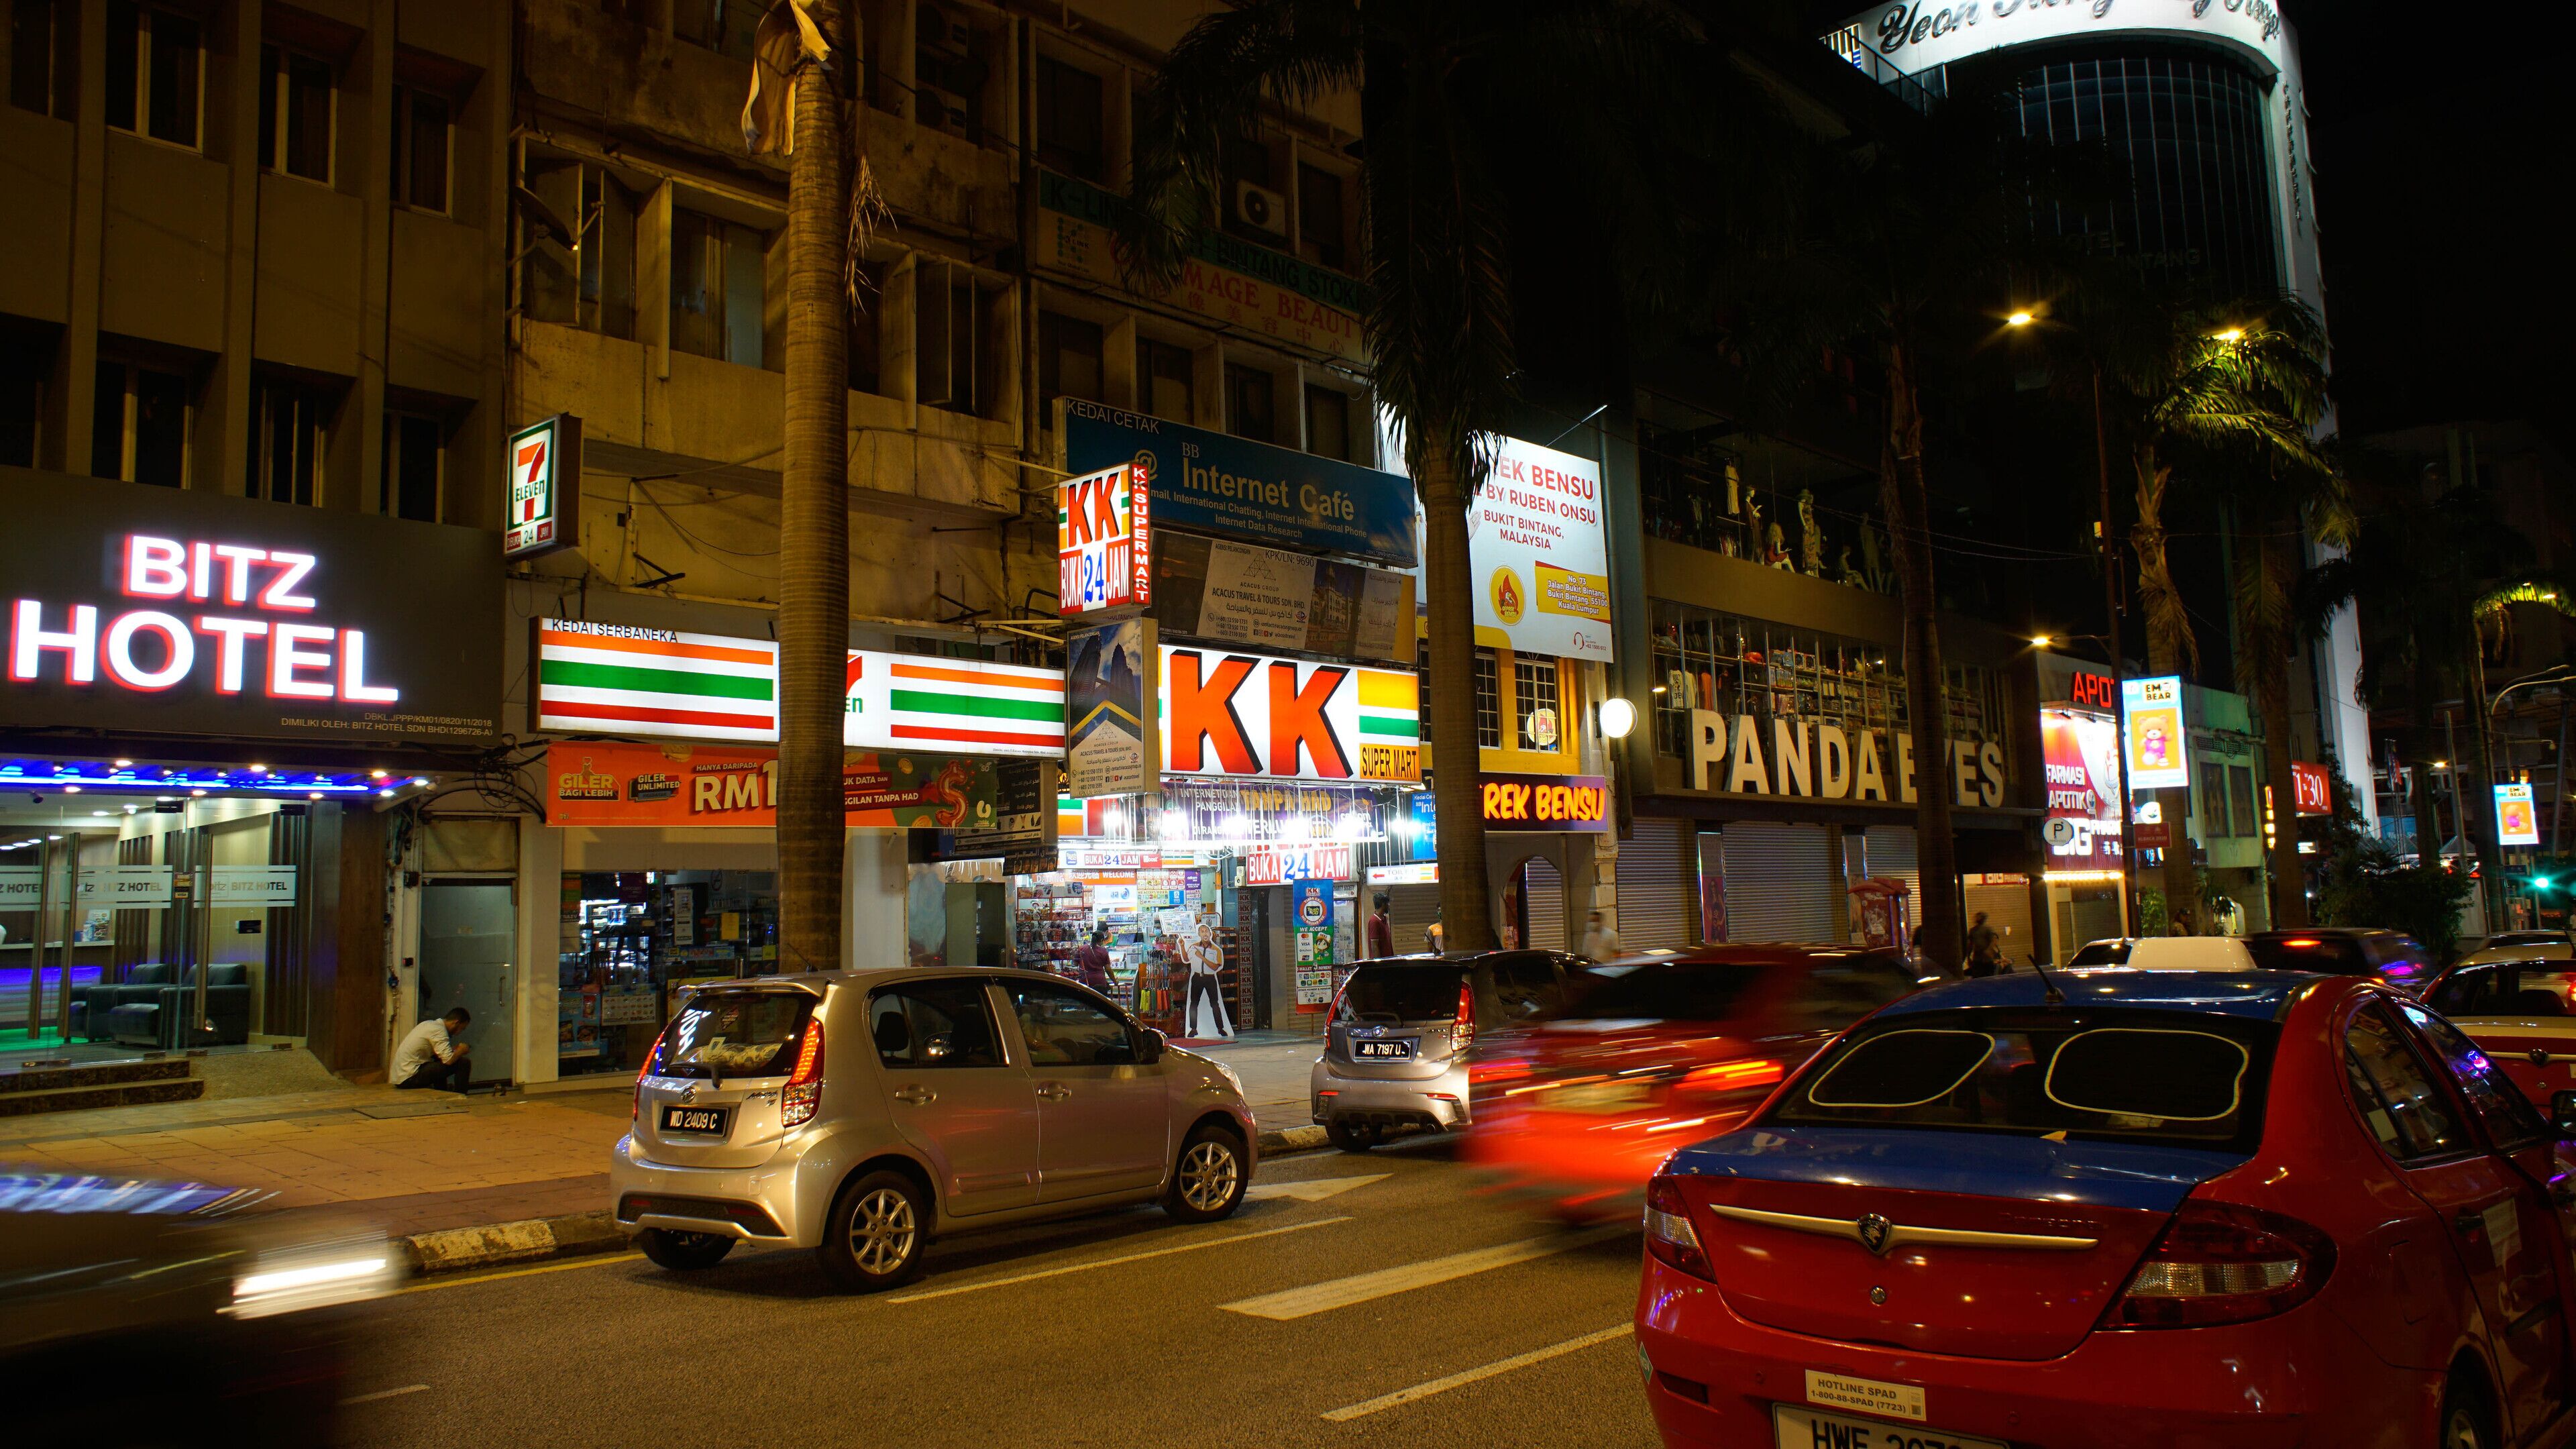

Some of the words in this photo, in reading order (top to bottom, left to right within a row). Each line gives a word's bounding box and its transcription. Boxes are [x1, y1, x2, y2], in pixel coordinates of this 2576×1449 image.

[1051, 178, 1122, 229] K-LIN
[1184, 264, 1260, 309] MAGE
[1277, 292, 1354, 339] BEAUT
[1067, 400, 1110, 423] KEDAI
[1114, 411, 1160, 435] CETAK
[1182, 442, 1199, 459] BB
[518, 440, 545, 523] 7
[1182, 456, 1289, 508] Internet
[1299, 483, 1355, 521] Café
[1532, 465, 1594, 500] BENSU
[1068, 472, 1120, 549] KK
[1151, 488, 1171, 503] mail,
[1173, 491, 1227, 512] International
[1228, 502, 1264, 521] Chatting,
[1266, 508, 1296, 523] Internet
[1297, 515, 1343, 535] International
[1344, 525, 1367, 539] Phone
[1487, 484, 1505, 502] BY
[1509, 490, 1556, 515] RUBEN
[1560, 502, 1596, 525] ONSU
[1215, 514, 1246, 529] Internet
[1248, 519, 1266, 532] Data
[1267, 523, 1303, 539] Research
[1484, 509, 1515, 527] BUKIT
[1518, 518, 1564, 539] BINTANG,
[523, 530, 534, 544] 24
[539, 527, 549, 538] JAM
[1499, 529, 1552, 550] MALAYSIA
[1265, 549, 1295, 564] KPK/LN:
[123, 535, 316, 613] BITZ
[1061, 554, 1083, 609] BUKA
[1083, 551, 1104, 604] 24
[1108, 544, 1129, 600] JAM
[1568, 575, 1578, 584] No.
[1579, 577, 1587, 585] 73
[1212, 587, 1235, 599] ACACUS
[1236, 590, 1256, 602] TRAVEL
[1257, 594, 1261, 602] &
[1263, 594, 1281, 605] TOURS
[1547, 590, 1564, 599] Bukit
[1565, 584, 1582, 594] Bukit
[1558, 600, 1576, 610] Kuala
[1577, 604, 1599, 615] Lumpur
[552, 619, 594, 635] KEDAI
[597, 624, 679, 643] SERBANEKA
[7, 598, 399, 705] HOTEL
[2146, 692, 2171, 701] BEAR
[1170, 649, 1354, 779] KK
[281, 718, 319, 728] DIMILIKI
[322, 719, 350, 729] OLEH:
[352, 721, 373, 730] BITZ
[375, 722, 405, 732] HOTEL
[407, 724, 426, 733] SDN
[696, 763, 721, 771] HANYA
[722, 761, 758, 771] DARIPADA
[1362, 745, 1391, 780] SUPER
[1393, 749, 1417, 780] MART
[1684, 708, 1888, 802] PANDA
[1893, 732, 2004, 808] EES
[558, 773, 613, 789] GILER
[638, 773, 665, 783] GILER
[856, 775, 876, 785] DATA
[2046, 764, 2085, 786] FARMASI
[558, 788, 582, 797] BAGI
[585, 789, 614, 797] LEBIH
[638, 781, 680, 791] UNLIMITED
[2308, 774, 2323, 806] 30
[874, 794, 900, 804] TANPA
[902, 792, 919, 801] HAD
[1196, 801, 1238, 812] PANGGILA
[1479, 783, 1530, 820] REK
[1536, 784, 1606, 822] BENSU
[2049, 790, 2086, 810] APOTIK
[1085, 854, 1104, 865] BUKA
[1104, 854, 1121, 865] 24
[1122, 854, 1140, 865] JAM
[1249, 851, 1279, 884] BUKA
[1284, 851, 1311, 881] 24
[1313, 846, 1348, 877] JAM
[1102, 871, 1135, 879] WELCOME
[7, 883, 42, 894] HOTE
[127, 881, 163, 892] HOTEL
[231, 881, 254, 892] BITZ
[256, 881, 288, 892] HOTEL
[1364, 1044, 1374, 1055] WA
[1377, 1044, 1393, 1055] 7197
[1395, 1044, 1401, 1055] U
[671, 1110, 683, 1122] WD
[686, 1111, 708, 1128] 2409
[708, 1113, 718, 1129] C
[1817, 1378, 1865, 1395] HOTLINE
[1868, 1386, 1897, 1400] SPAD
[1811, 1389, 1874, 1408] 1-800-88-SPAD
[1876, 1400, 1907, 1415] (7723)
